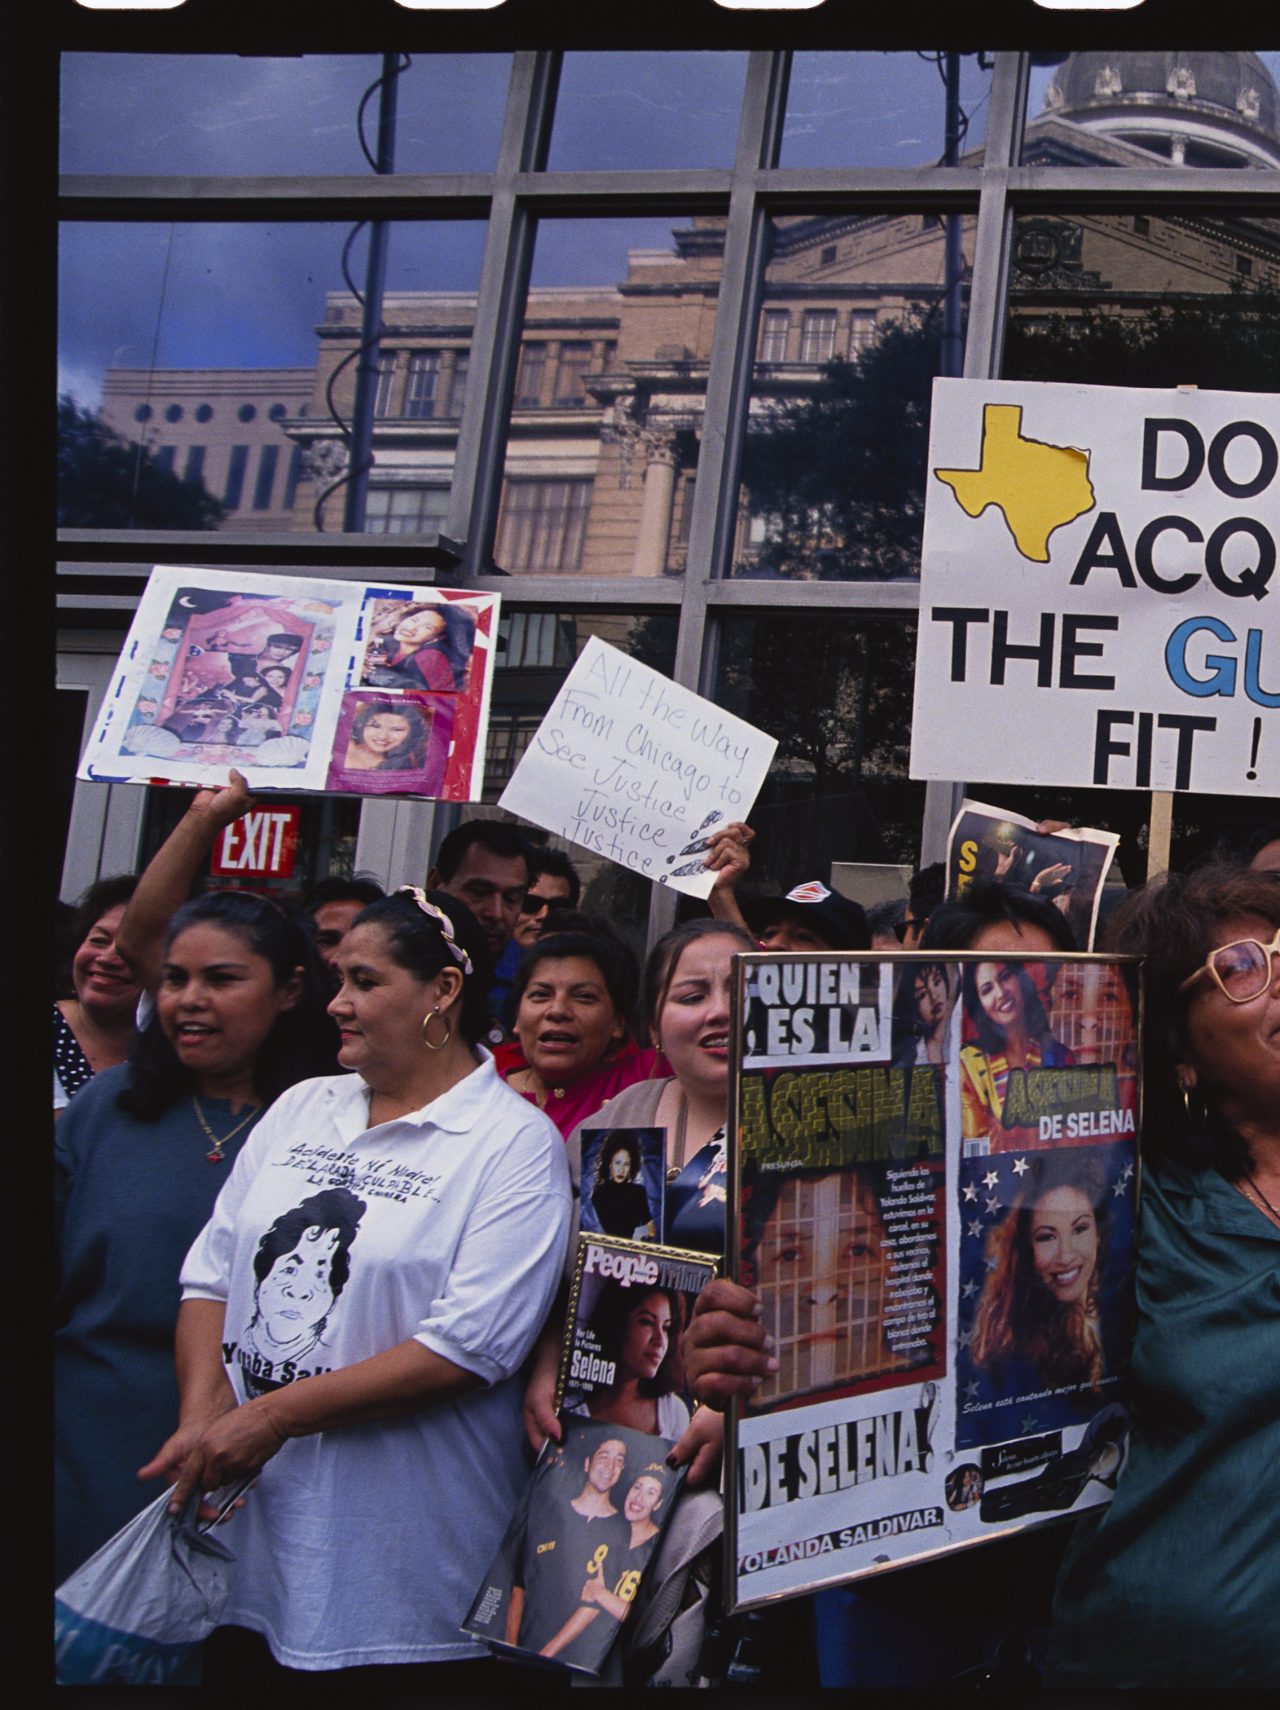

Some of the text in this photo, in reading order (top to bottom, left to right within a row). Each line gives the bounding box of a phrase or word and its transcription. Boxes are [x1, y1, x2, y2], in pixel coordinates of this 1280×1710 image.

[931, 606, 1119, 691] THE
[584, 652, 632, 698] All
[639, 679, 686, 728] the
[537, 729, 587, 770] See
[625, 723, 712, 801] Chicago
[718, 775, 742, 806] to
[1092, 708, 1217, 790] FIT
[220, 811, 292, 871] EXIT
[1039, 1109, 1135, 1141] DE SELENA
[583, 1244, 659, 1288] People
[570, 1350, 616, 1386] Selena
[962, 1401, 997, 1414] Selena
[744, 1436, 789, 1514] DE
